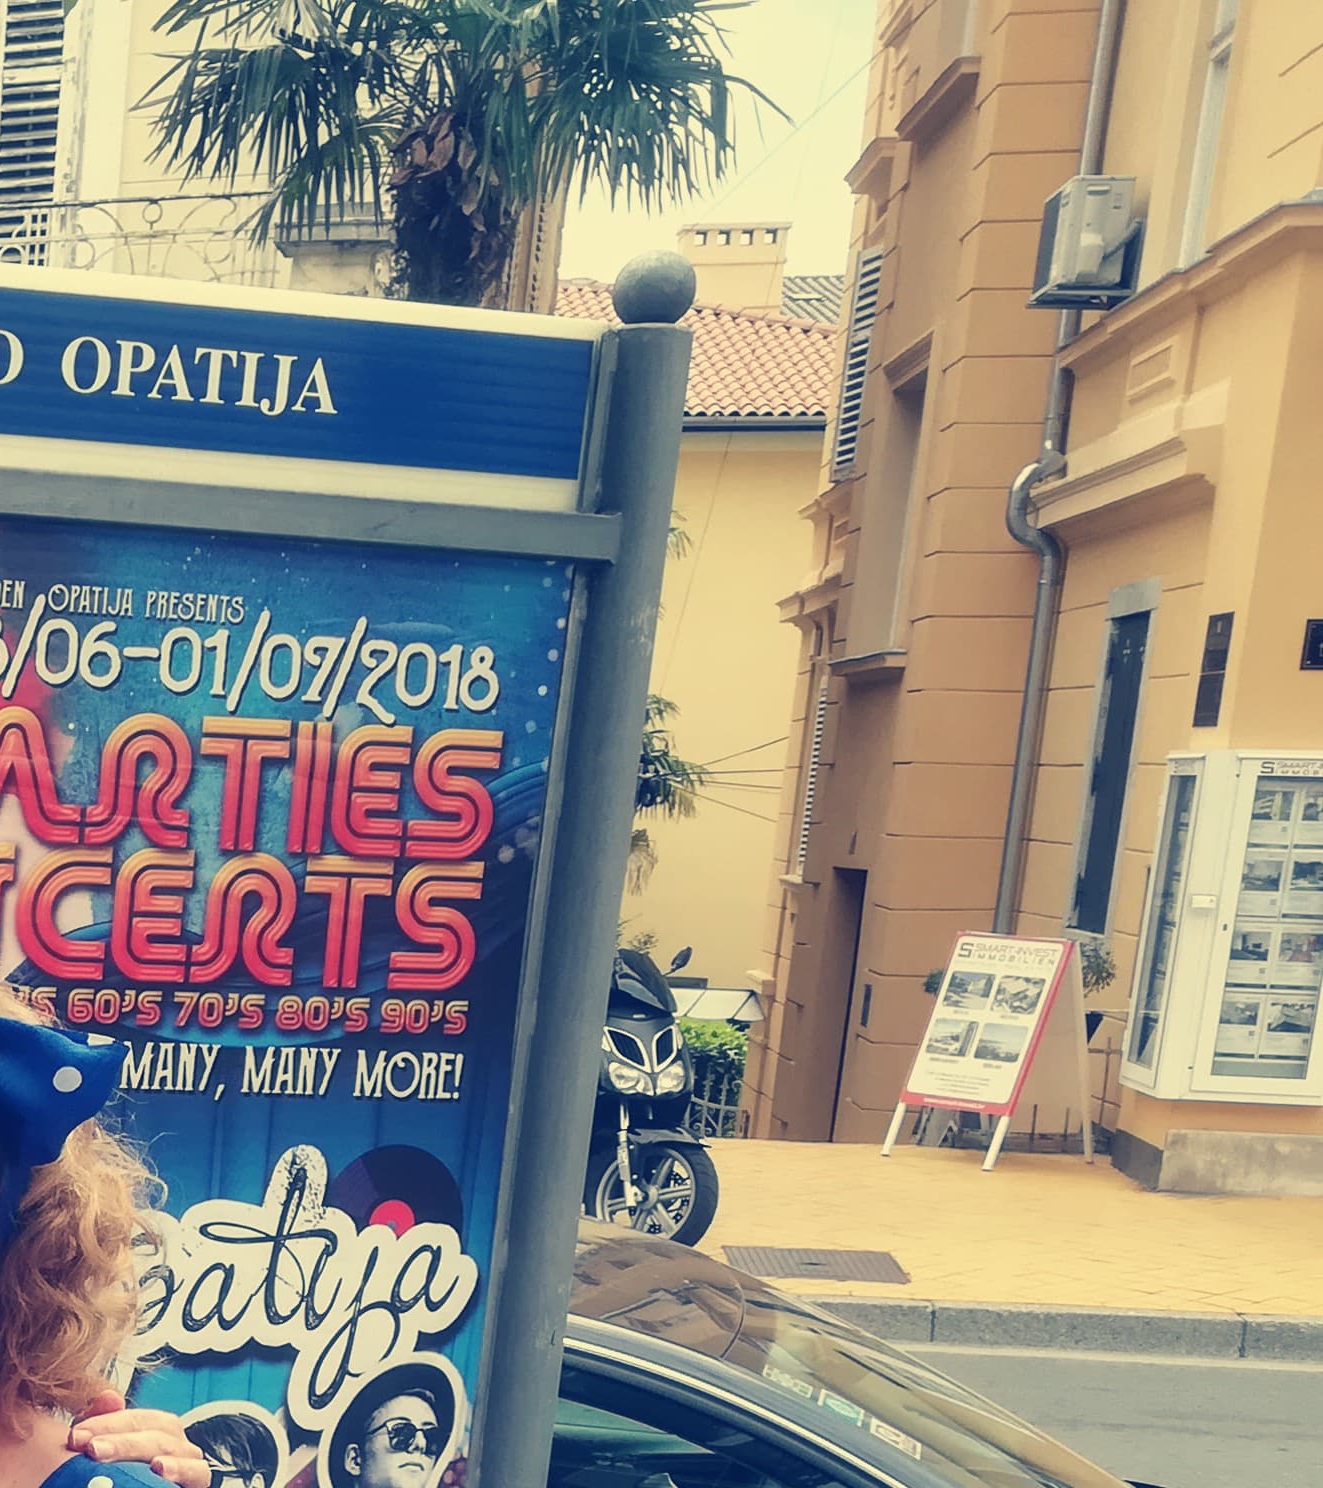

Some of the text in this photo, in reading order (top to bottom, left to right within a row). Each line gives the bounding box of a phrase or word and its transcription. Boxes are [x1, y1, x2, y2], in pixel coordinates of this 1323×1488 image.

[59, 335, 340, 417] OPATIJA
[47, 583, 134, 618] OPATIJA
[144, 590, 246, 624] PRESENTS
[66, 987, 162, 1025] 60'S
[173, 991, 266, 1029] 70'S
[274, 995, 370, 1032] 80'S
[379, 999, 470, 1035] 90'S
[119, 1040, 465, 1101] MANY, MANY MORE!
